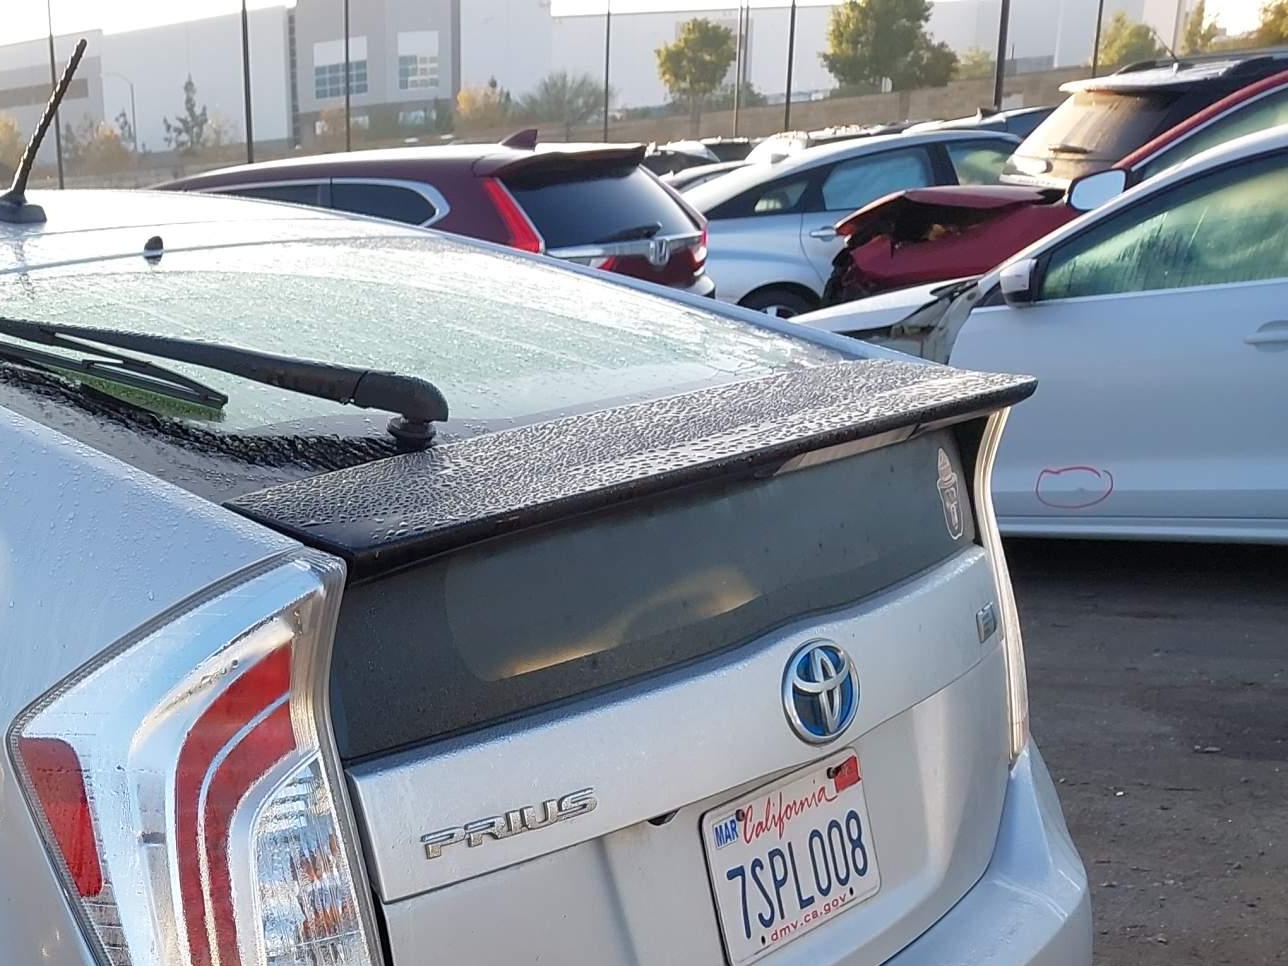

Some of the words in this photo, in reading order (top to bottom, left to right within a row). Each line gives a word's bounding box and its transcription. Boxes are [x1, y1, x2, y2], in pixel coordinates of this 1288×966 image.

[420, 786, 598, 859] PRIUS
[714, 819, 739, 847] MAR
[743, 779, 838, 844] California
[726, 809, 868, 940] 7SPL008
[770, 892, 848, 942] dmv.ca.gov
